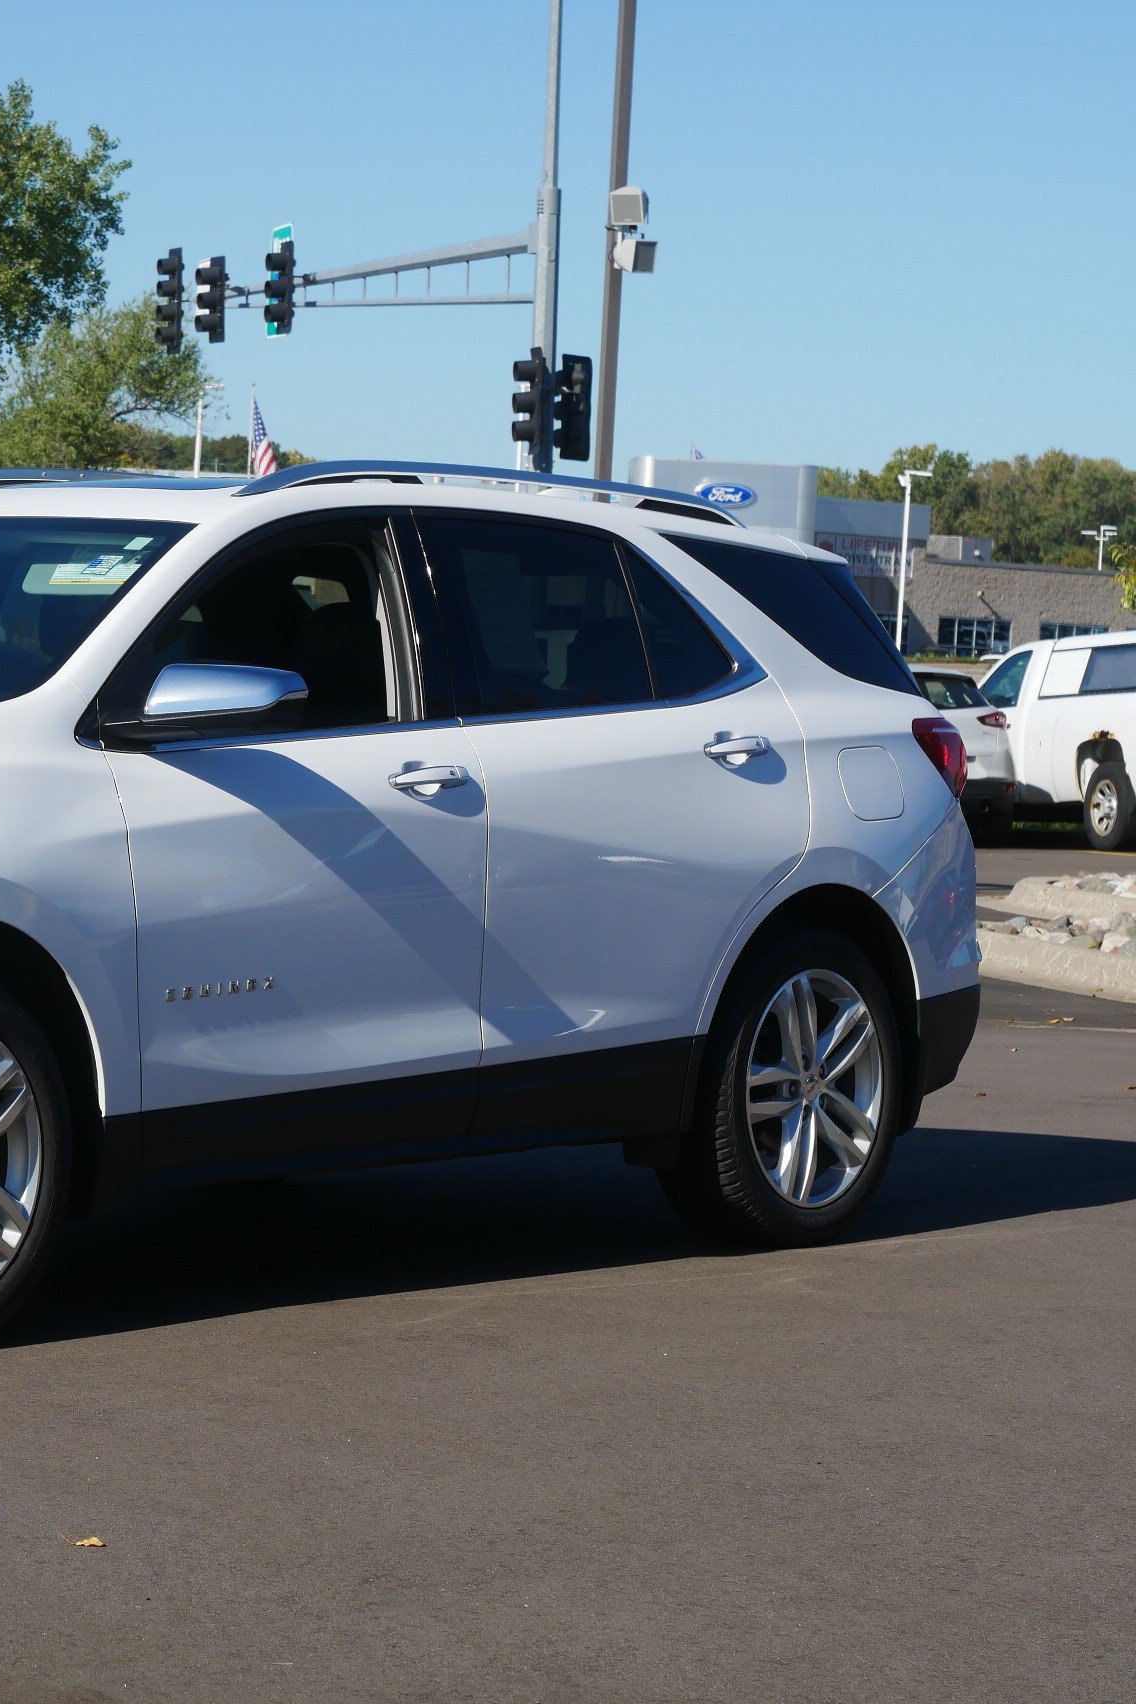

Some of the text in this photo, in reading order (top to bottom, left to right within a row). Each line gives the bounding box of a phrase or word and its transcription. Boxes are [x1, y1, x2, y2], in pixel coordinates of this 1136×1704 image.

[708, 487, 743, 502] Ford
[841, 538, 906, 553] LIFETIM
[166, 977, 274, 1002] EQUINOX
